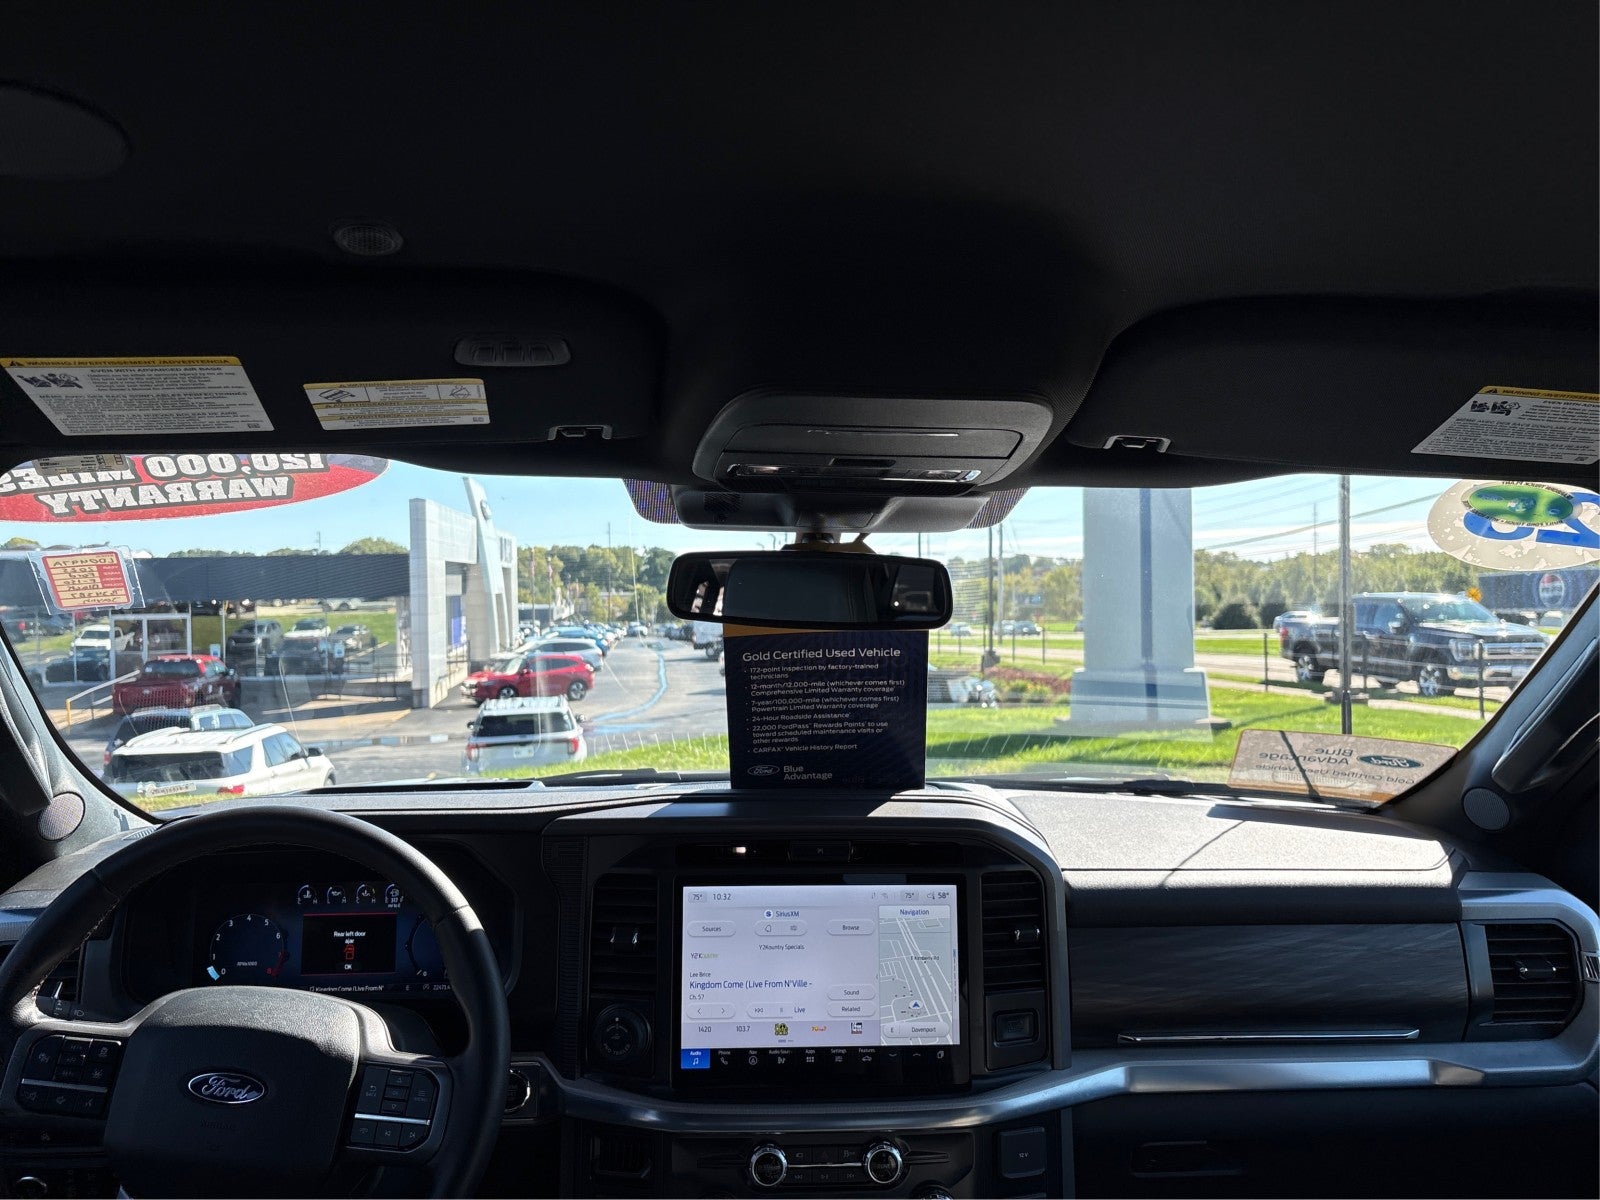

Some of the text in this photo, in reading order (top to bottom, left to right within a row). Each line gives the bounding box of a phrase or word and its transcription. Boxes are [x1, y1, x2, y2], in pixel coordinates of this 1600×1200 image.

[743, 648, 900, 662] Gold Certified Used Vehicle
[784, 772, 832, 780] Advantage
[900, 908, 930, 917] Navigation
[690, 980, 720, 990] Kingdom
[721, 980, 743, 988] Come
[745, 979, 763, 989] (Live
[764, 979, 783, 988] From
